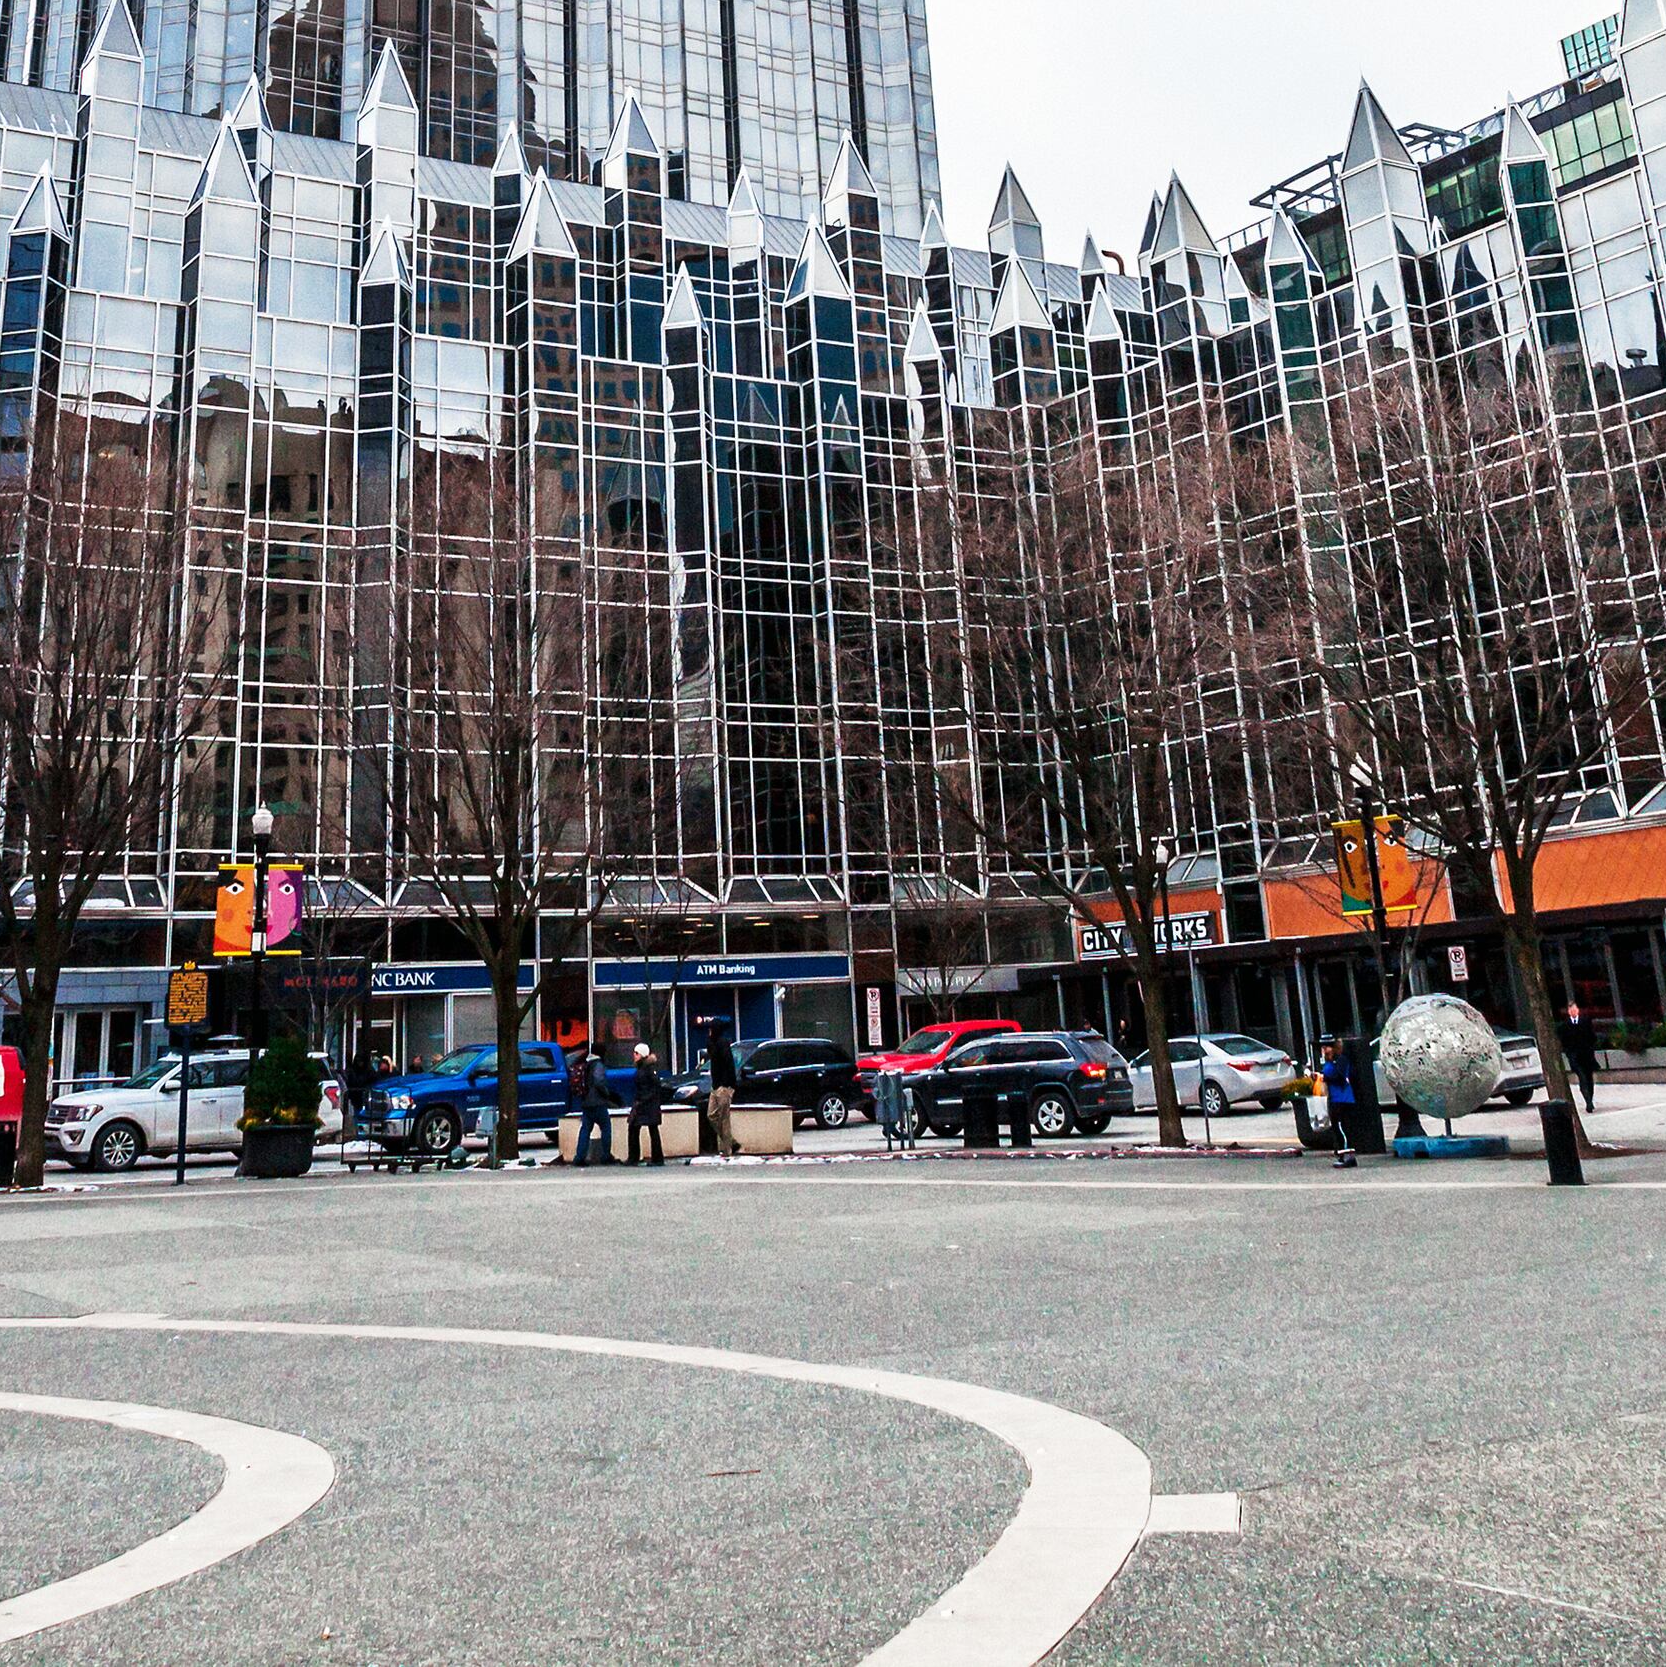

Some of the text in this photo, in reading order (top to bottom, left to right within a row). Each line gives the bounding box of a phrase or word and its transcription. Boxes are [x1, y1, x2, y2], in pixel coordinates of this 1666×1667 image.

[696, 963, 755, 976] ATM Banking
[371, 972, 436, 987] NC BANK
